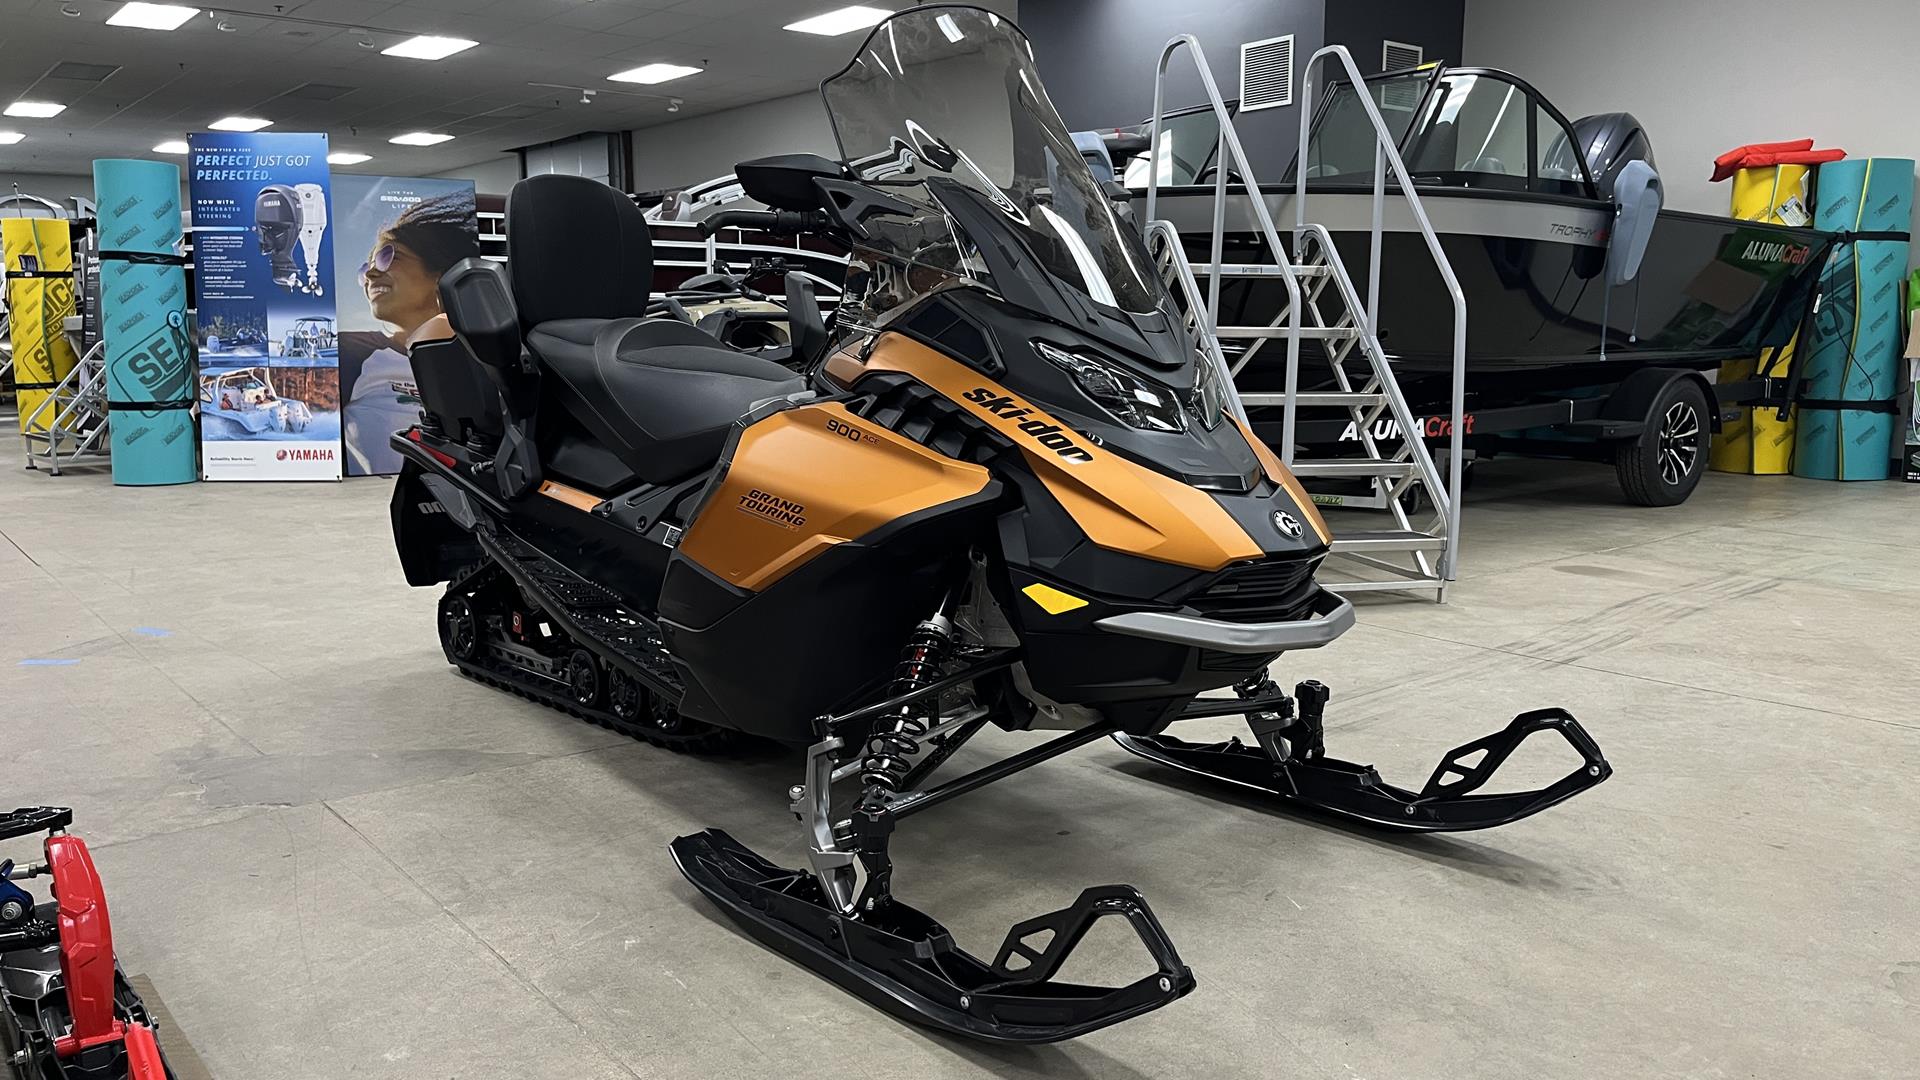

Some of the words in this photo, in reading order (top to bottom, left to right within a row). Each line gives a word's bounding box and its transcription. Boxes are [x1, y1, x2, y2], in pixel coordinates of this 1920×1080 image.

[196, 155, 252, 166] PERFECT
[253, 155, 283, 169] JUST
[285, 155, 311, 167] GOT
[197, 170, 272, 181] PERFECTED.
[1741, 240, 1809, 264] ALUMACraft
[826, 419, 861, 442] 900
[863, 434, 880, 445] ACE
[962, 388, 1094, 464] ski-doo
[289, 449, 334, 461] YAMAHA
[739, 495, 807, 526] TOURING
[749, 489, 805, 515] GRAND
